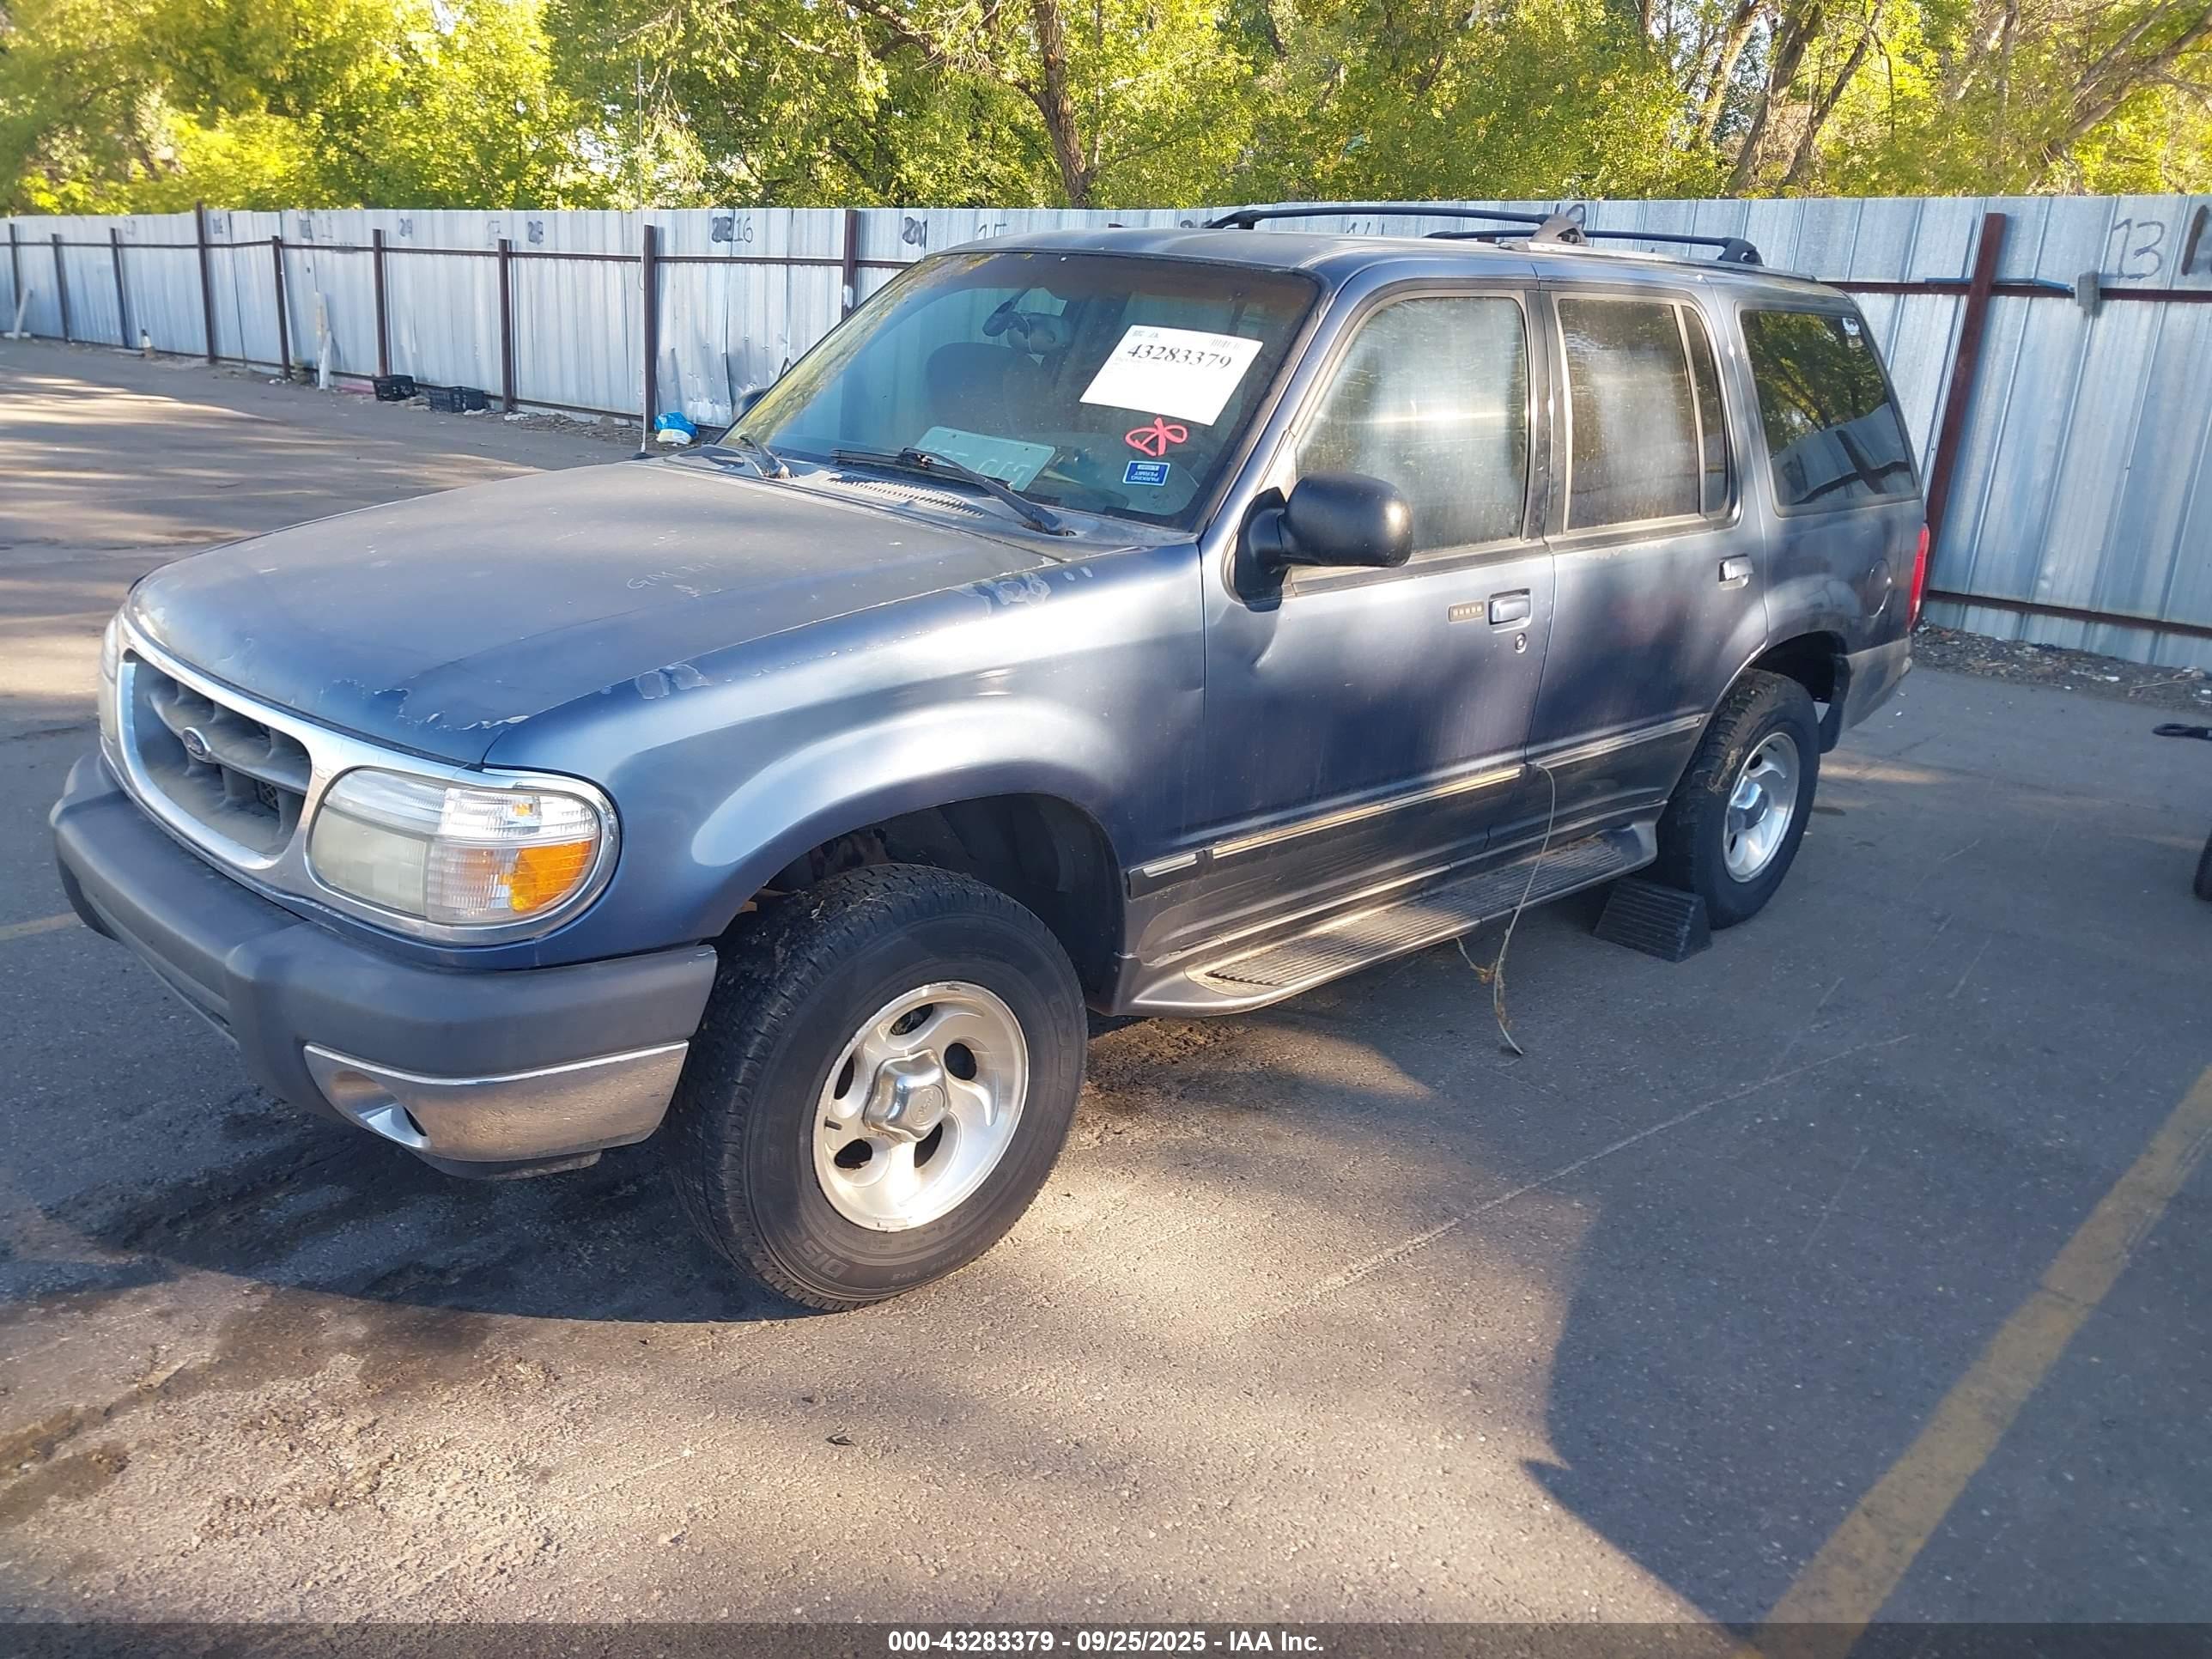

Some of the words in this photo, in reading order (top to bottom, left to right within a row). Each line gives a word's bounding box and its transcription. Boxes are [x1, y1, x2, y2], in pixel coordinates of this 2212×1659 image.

[733, 216, 753, 243] 16
[2112, 218, 2165, 282] 13
[1127, 343, 1232, 369] 43283379
